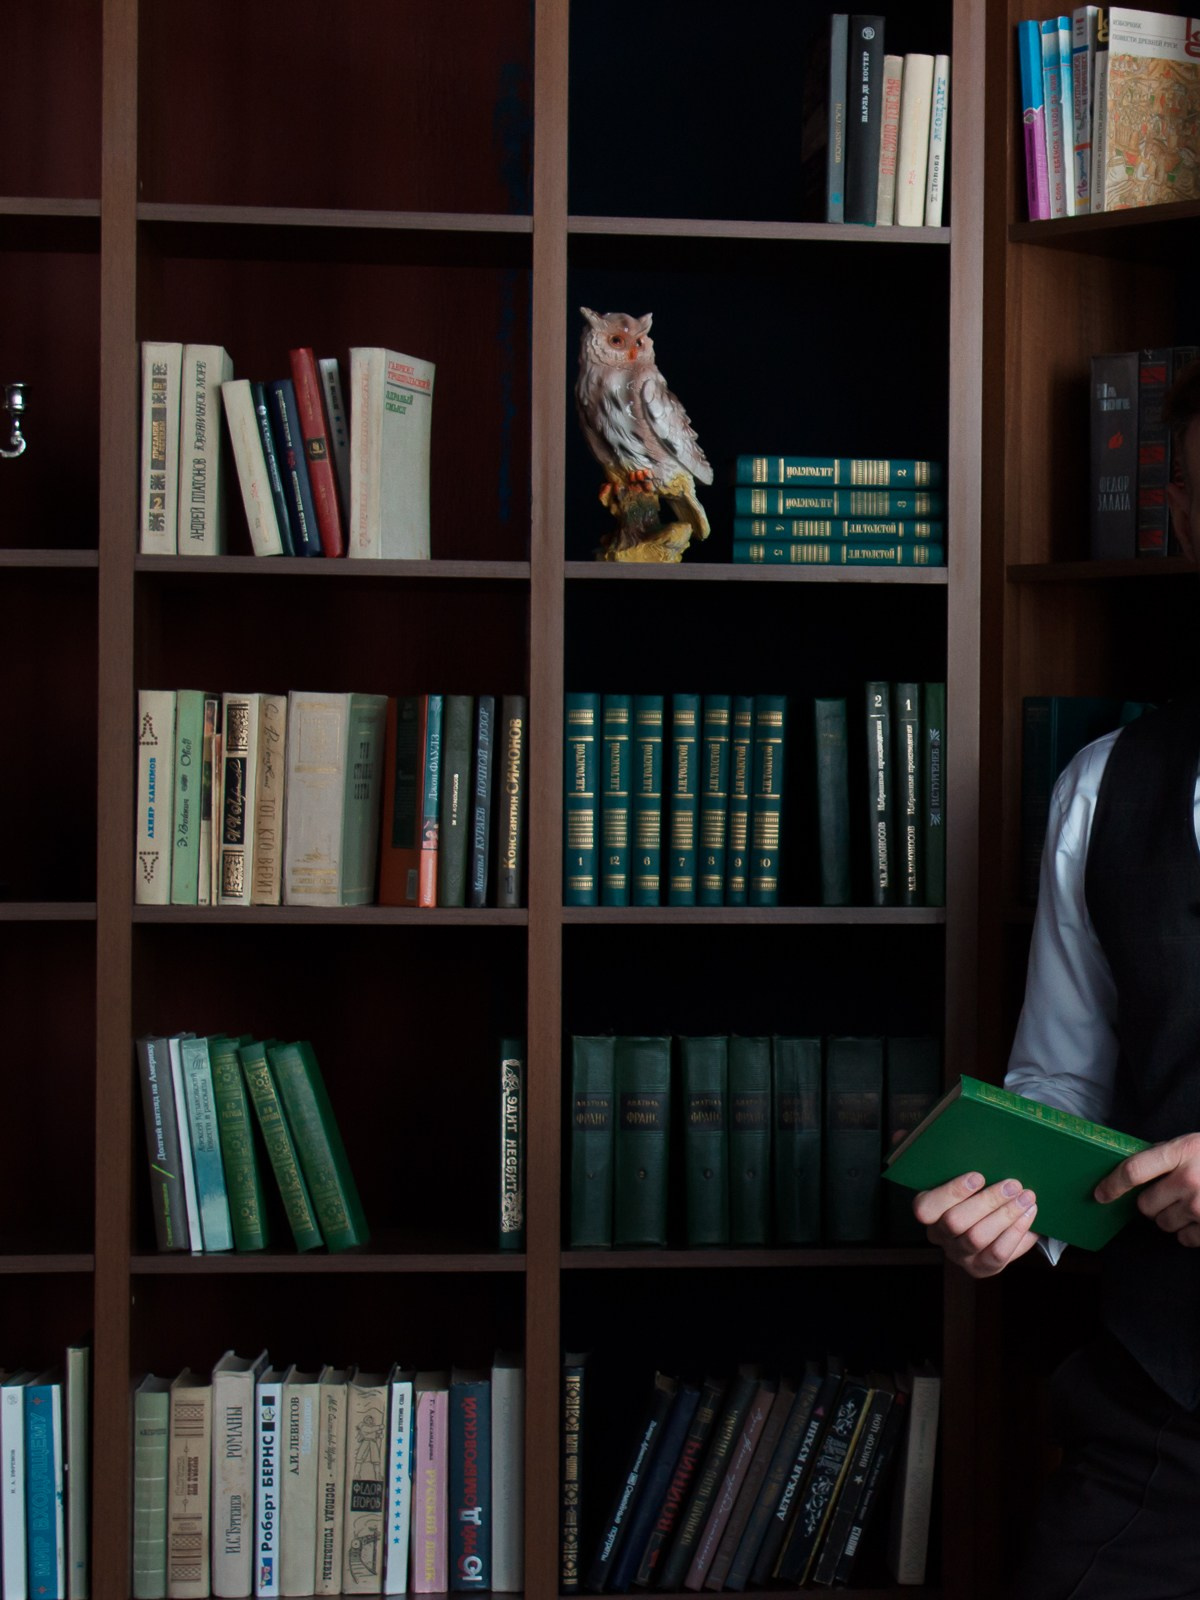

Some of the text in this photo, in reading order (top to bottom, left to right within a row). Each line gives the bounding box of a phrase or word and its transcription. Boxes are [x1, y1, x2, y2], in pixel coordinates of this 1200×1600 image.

[861, 50, 870, 123] ШАРЛЬ ДЕ КОСТЕР
[886, 78, 900, 97] РАЯ
[884, 97, 899, 120] ТЕБЕ
[933, 76, 947, 142] МОЦАРТ
[882, 153, 896, 167] НЕ
[931, 154, 941, 192] Попова
[385, 402, 407, 415] СМЫСЛ
[190, 361, 208, 542] АНДРЕЙ ПЛАТОНОВ ЮВЕНИЛЬНОЕ МОРЕ
[897, 469, 908, 477] 2
[152, 496, 164, 509] 2
[874, 694, 883, 708] 2
[905, 698, 912, 711] 1
[428, 733, 442, 801] Джон ФАУЛЗ
[147, 758, 157, 839] АХИЯР ХАКИМОВ
[473, 707, 491, 893] Михаил КУРАЕВ НОЧНОЙ ДОЗОР
[503, 718, 523, 869] Константин СИМОНОВ
[877, 770, 887, 811] Избранные
[906, 774, 916, 815] Избранные
[178, 799, 190, 835] Войнич
[257, 827, 275, 851] КТО
[256, 857, 274, 896] ВЕРИТ
[578, 856, 584, 867] 1
[643, 857, 652, 866] 6
[677, 857, 687, 867] 7
[707, 855, 716, 865] 8
[734, 857, 743, 867] 9
[146, 1043, 168, 1161] Долгий взгляд на Америку
[204, 1122, 215, 1153] Повести
[505, 1095, 519, 1192] ЭДИТ НЕСБИТ
[226, 1406, 243, 1459] РОМАНЫ
[289, 1397, 300, 1450] ЛЕВИТОВ
[397, 1408, 405, 1433] ДЕТЕКТИВ
[858, 1433, 880, 1468] ВИКТОР
[870, 1413, 884, 1434] ЦОЙ
[353, 1481, 383, 1496] ФЕДОР
[457, 1396, 483, 1581] ЮРИЙ ДОМБРОВСКИЙ
[775, 1419, 821, 1521] ДЕТСКАЯ КУХНЯ
[30, 1412, 51, 1577] МИР ВХОДЯЩЕМУ
[260, 1435, 276, 1552] Роберт БЕРНС
[324, 1483, 336, 1522] ГОСПОДА
[352, 1495, 382, 1512] ЕГОРОВ
[322, 1527, 336, 1581] ГОЛОВЛЕВЫ
[600, 1524, 619, 1562] портреты
